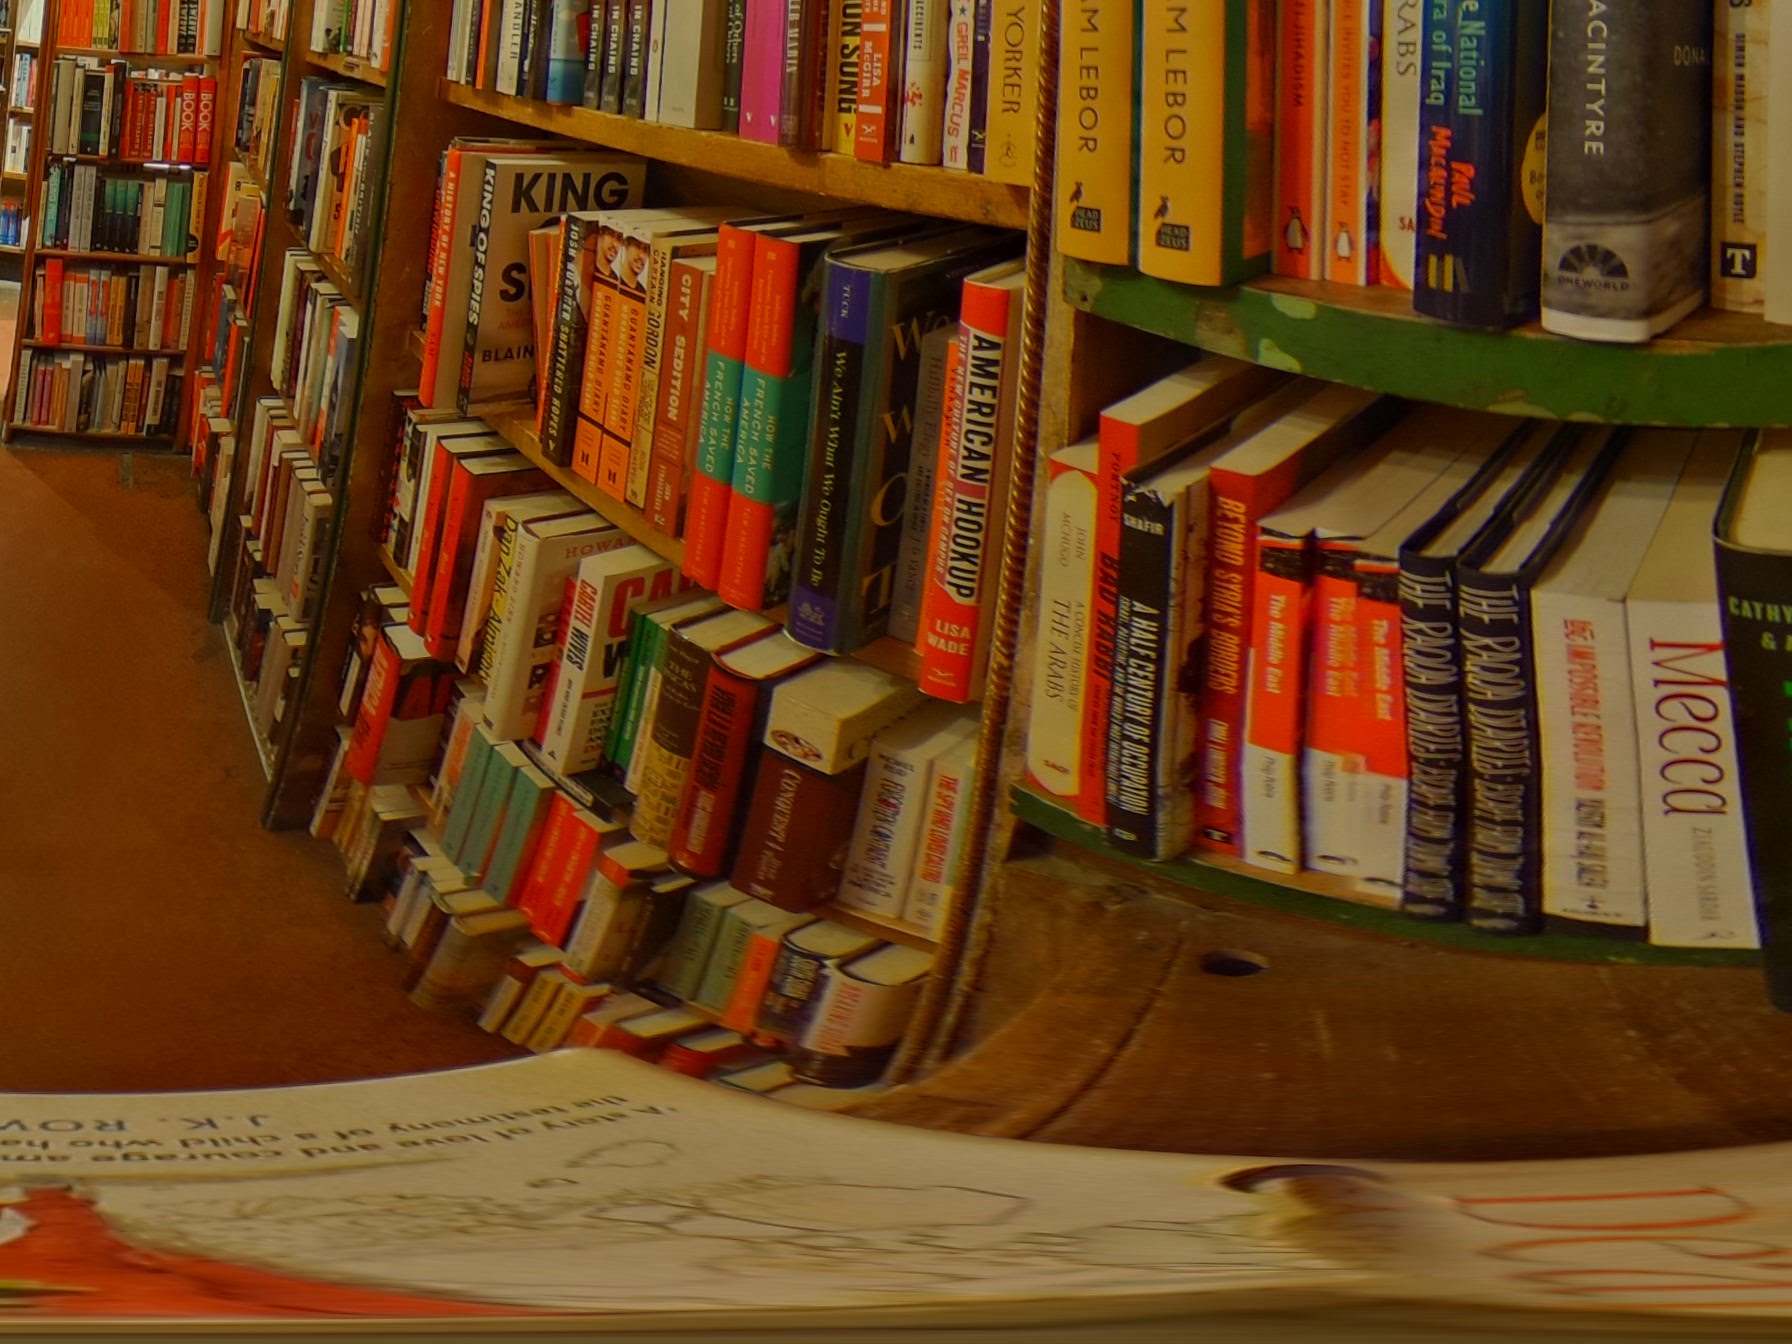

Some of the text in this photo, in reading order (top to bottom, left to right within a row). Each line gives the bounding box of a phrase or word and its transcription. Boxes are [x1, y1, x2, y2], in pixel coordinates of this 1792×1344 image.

[629, 26, 642, 76] CHAINS
[955, 22, 971, 66] GREIL
[1426, 60, 1452, 106] Iraq
[1458, 21, 1486, 116] National
[946, 69, 968, 151] MARCUS
[1076, 45, 1100, 156] LEBOR
[1162, 46, 1190, 168] LEBOR
[511, 170, 630, 214] KING
[467, 167, 496, 326] KING SPIES
[666, 335, 688, 422] SEDITION
[743, 378, 767, 495] FRENCH SAVED
[946, 336, 1002, 599] AMERICAN HOOKUP
[1215, 496, 1247, 567] BEYOND
[927, 633, 970, 656] WADE
[934, 619, 971, 639] LISA
[1118, 660, 1156, 816] CENTURY OCCUPATION
[1649, 636, 1729, 817] Mecca
